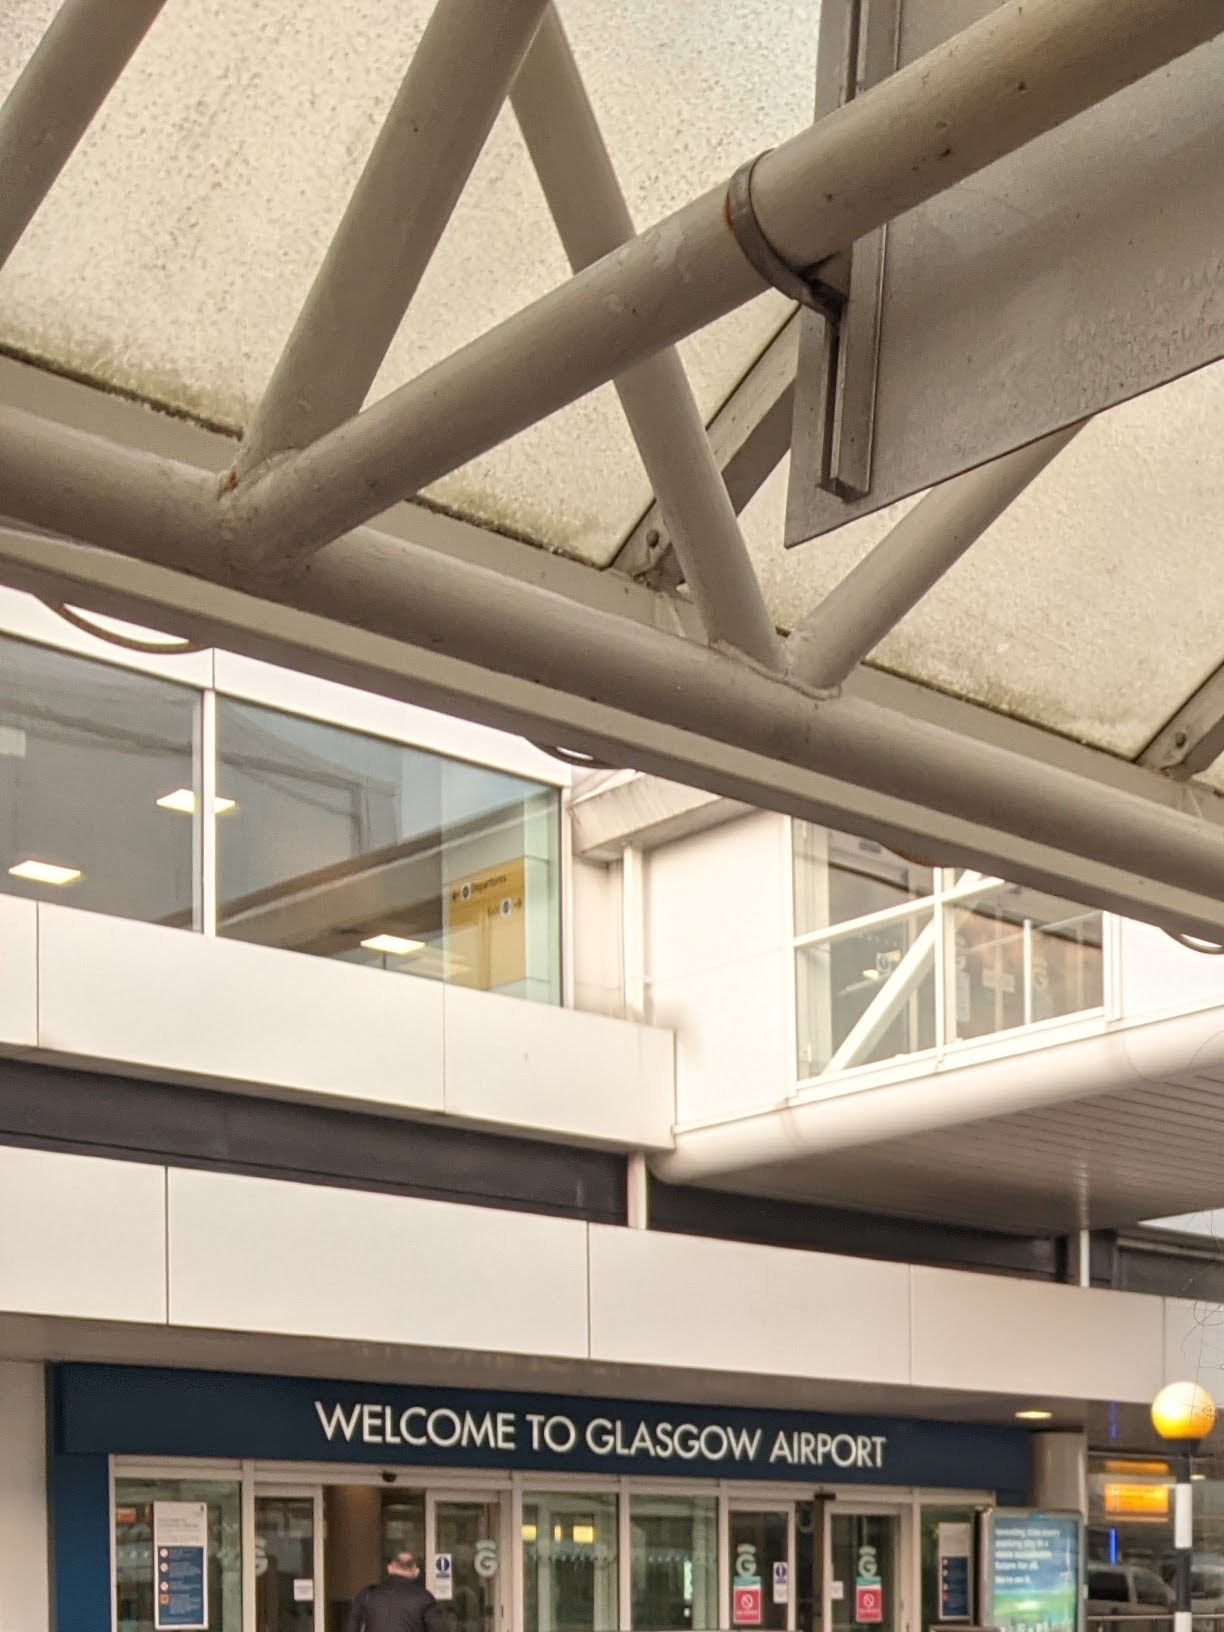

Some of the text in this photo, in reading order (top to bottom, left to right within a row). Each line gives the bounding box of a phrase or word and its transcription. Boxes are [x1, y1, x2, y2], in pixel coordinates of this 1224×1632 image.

[314, 1400, 887, 1468] WELCOME TO GLASGOW AIRPORT
